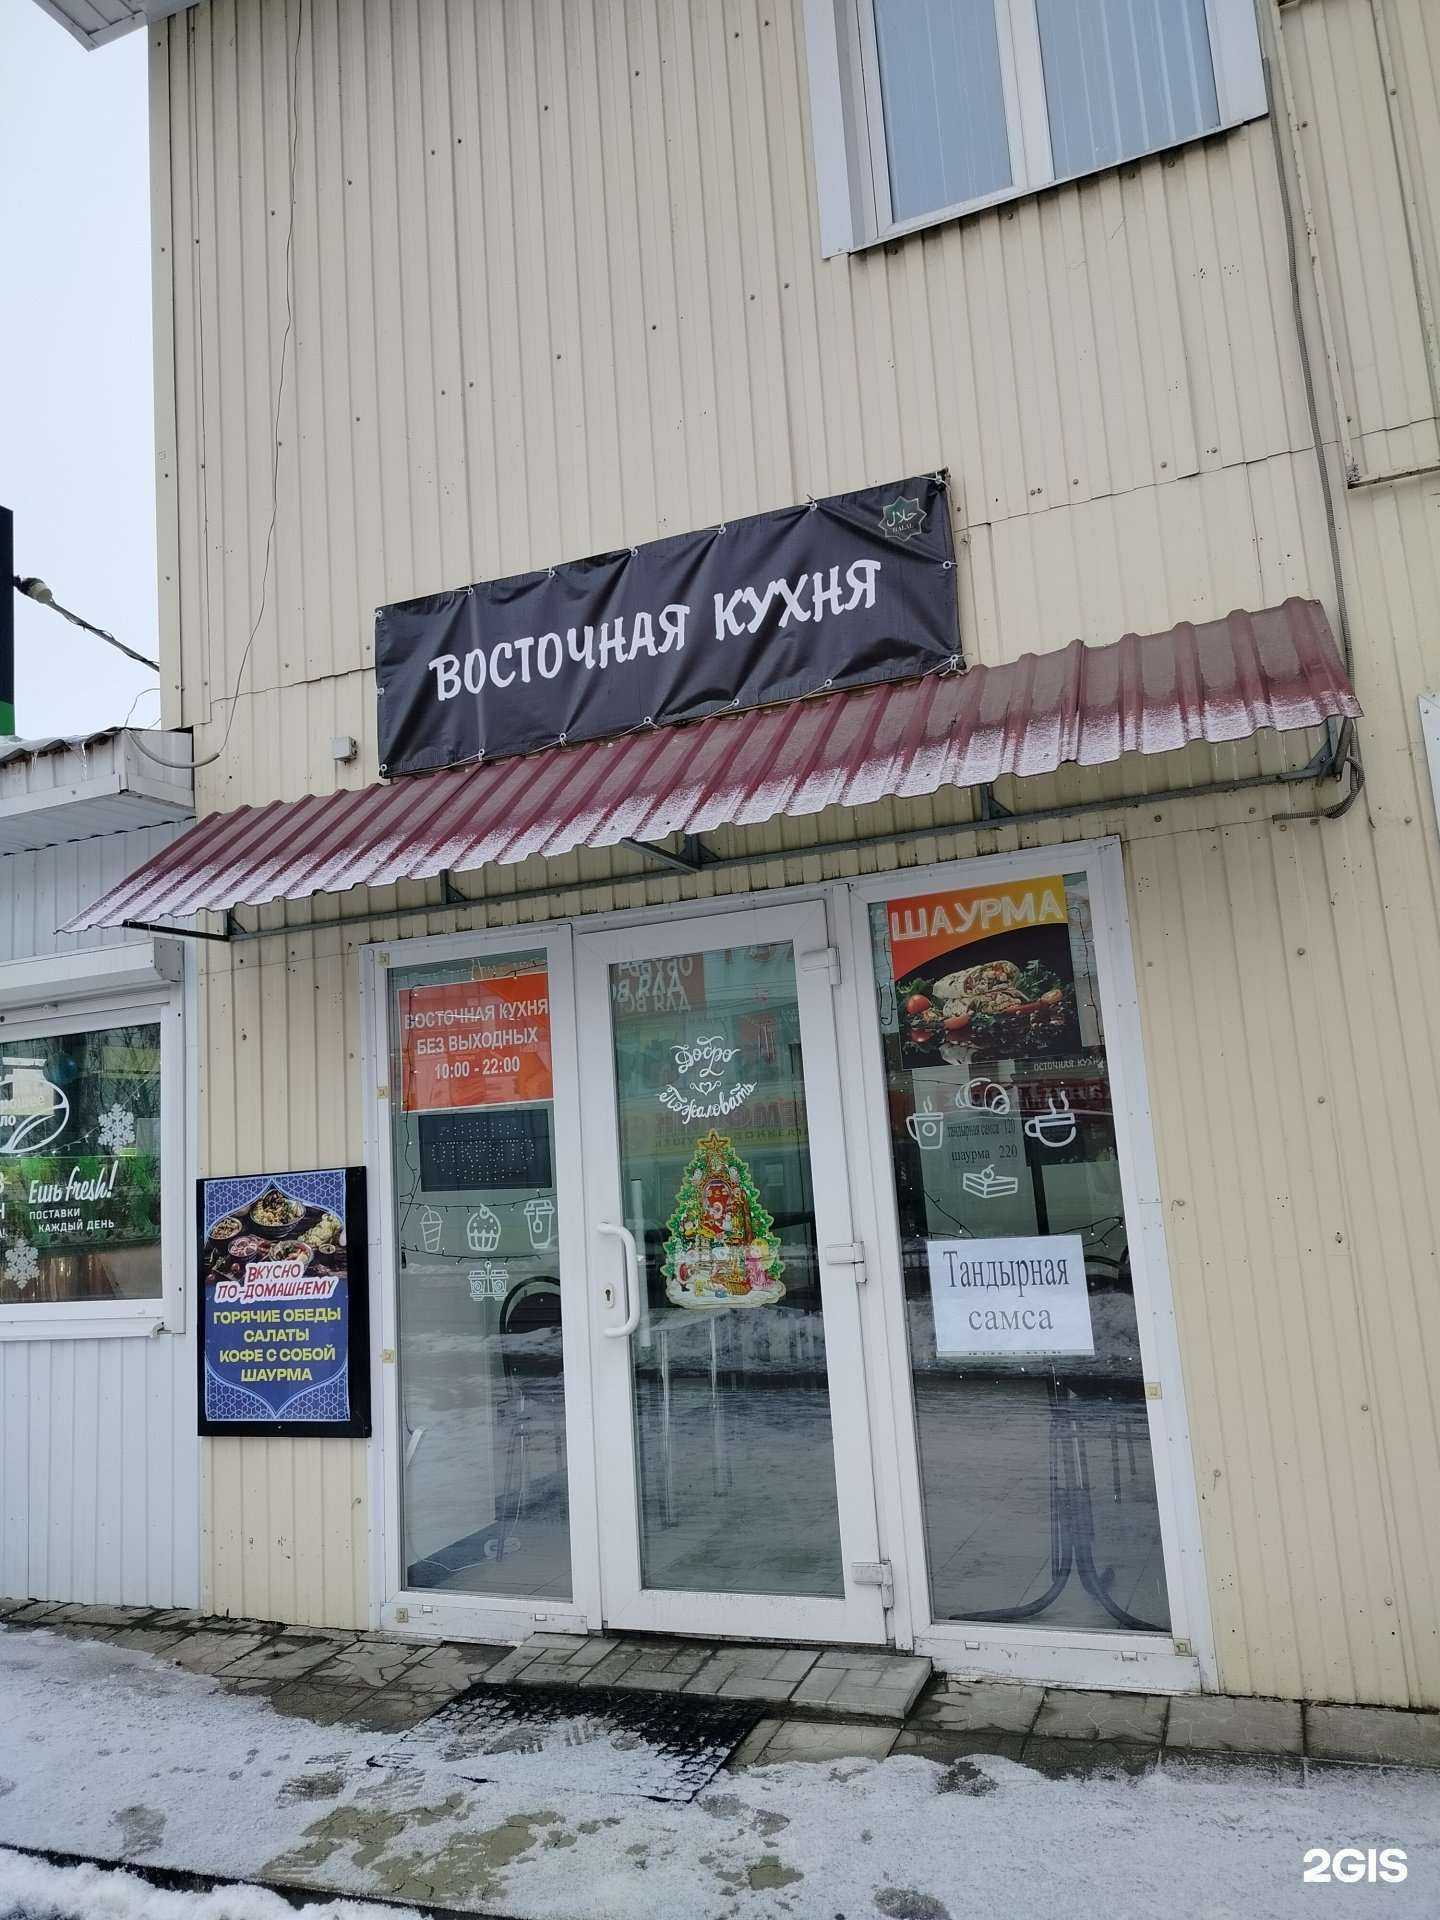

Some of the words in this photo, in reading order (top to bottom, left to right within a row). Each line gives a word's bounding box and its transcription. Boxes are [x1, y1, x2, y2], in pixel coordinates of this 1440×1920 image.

[428, 604, 690, 701] ВОСТОЧНАЯ
[713, 560, 882, 641] КУХНЯ
[891, 890, 1064, 941] ШАУРМА
[404, 1004, 495, 1030] ВОСТОЧНАЯ
[499, 998, 549, 1019] КУХНЯ
[417, 1037, 445, 1055] БЕЗ
[448, 1027, 539, 1052] ВЫХОДНЫХ
[670, 1035, 742, 1077] Добро
[434, 1061, 470, 1079] 10:00
[482, 1056, 520, 1075] 22:00
[952, 1150, 990, 1163] шаурма
[999, 1144, 1018, 1158] 220
[29, 1180, 62, 1203] Ешь
[65, 1160, 119, 1201] fresh!
[29, 1207, 80, 1220] ПОСТАВКИ
[38, 1219, 83, 1233] КАЖДЫЙ
[87, 1219, 115, 1231] ДЕНЬ
[247, 1264, 301, 1282] ВКУСНО
[943, 1250, 1070, 1297] Тандырная
[217, 1280, 334, 1300] ПО-ДОМАШНЕМУ
[213, 1309, 281, 1325] ГОРЯЧИЕ
[283, 1307, 341, 1322] ОБЕДЫ
[968, 1309, 1054, 1330] самса
[243, 1328, 309, 1342] САЛАТЫ
[219, 1348, 263, 1363] КОФЕ
[265, 1348, 277, 1362] С
[279, 1344, 336, 1361] СОБОЙ
[240, 1367, 312, 1382] ШАУРМА
